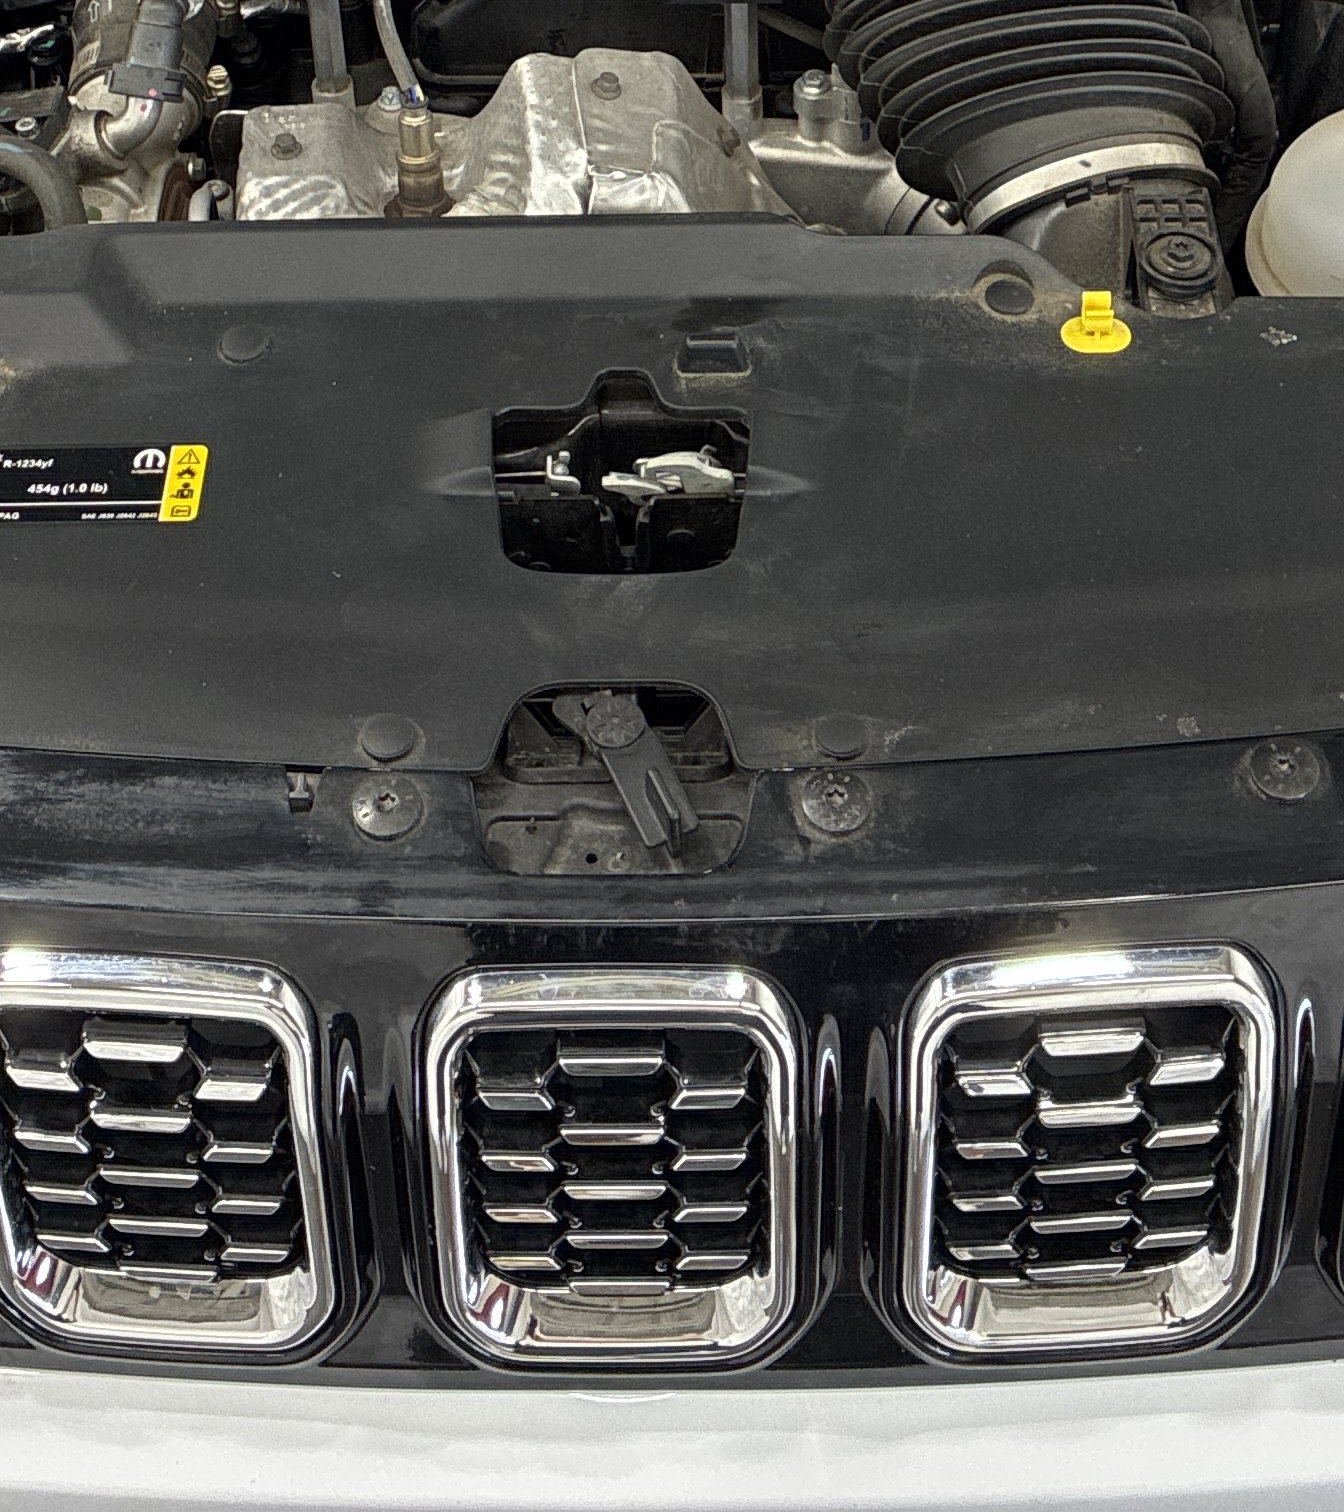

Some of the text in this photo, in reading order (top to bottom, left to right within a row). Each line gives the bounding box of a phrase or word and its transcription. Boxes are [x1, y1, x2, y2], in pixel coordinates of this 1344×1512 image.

[2, 458, 54, 470] R-1234yf
[27, 482, 108, 496] 454g (1.0 lb)
